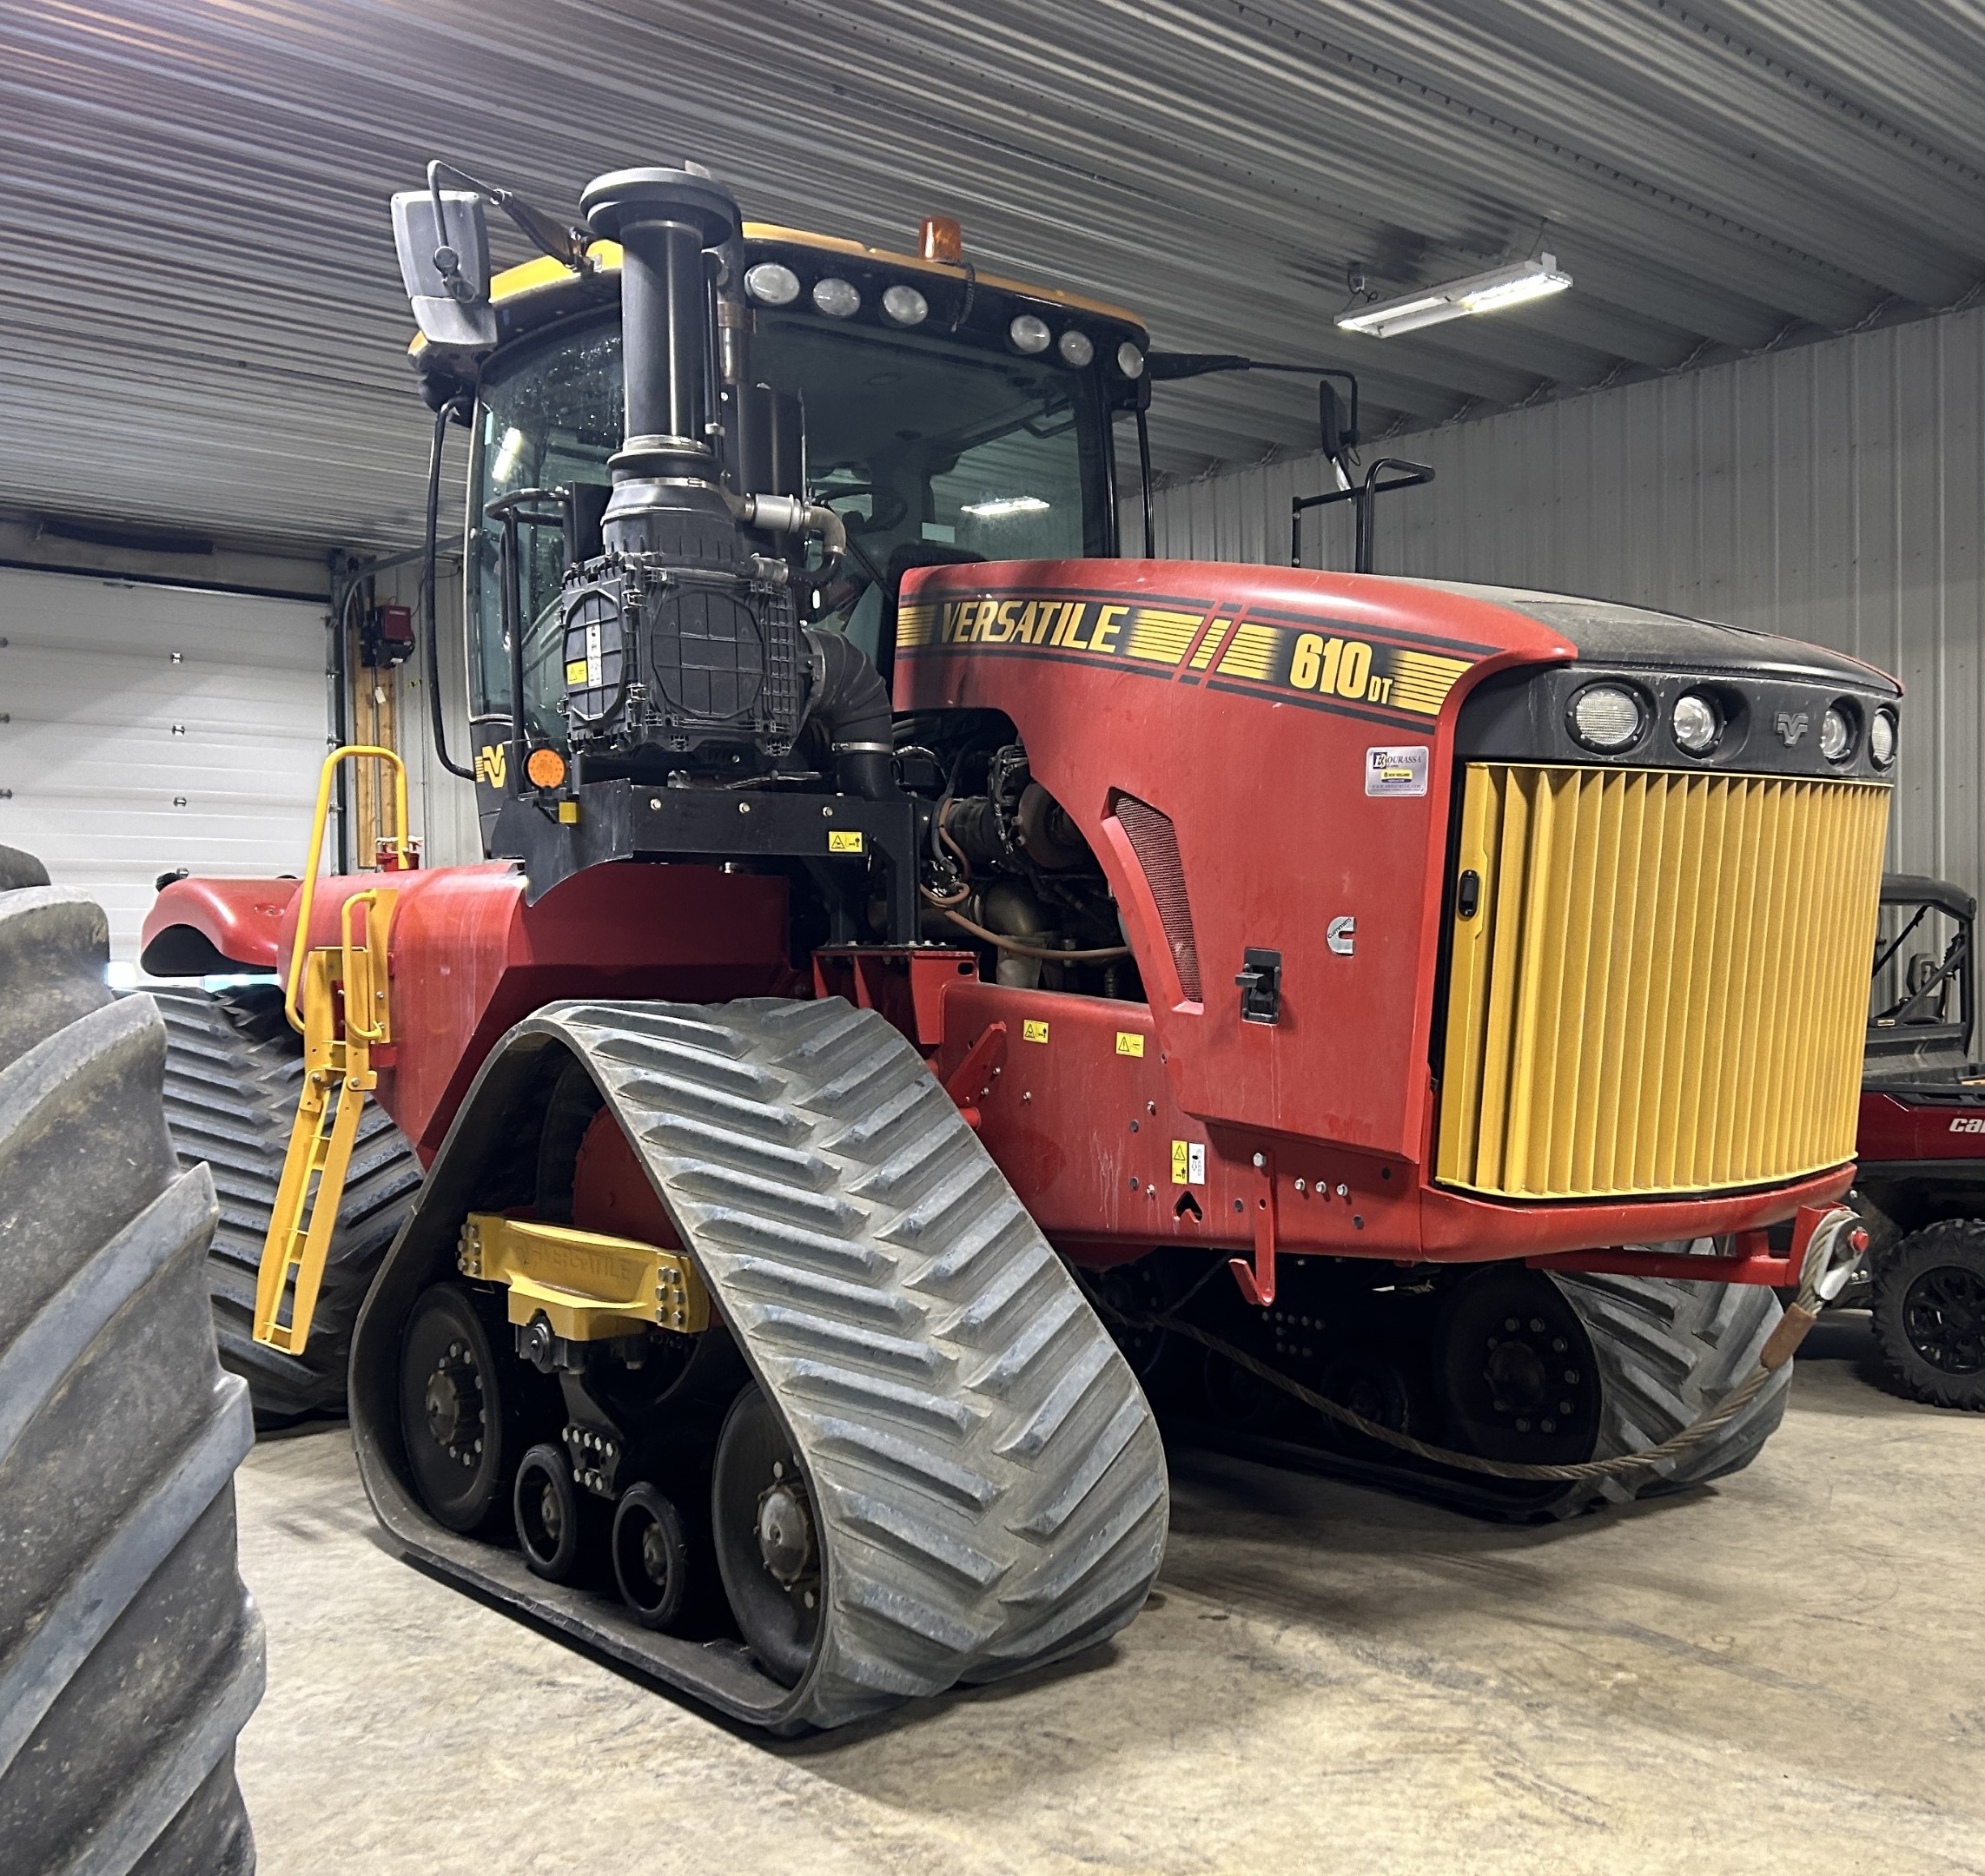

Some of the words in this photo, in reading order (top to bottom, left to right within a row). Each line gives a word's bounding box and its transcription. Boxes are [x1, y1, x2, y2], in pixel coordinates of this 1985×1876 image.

[942, 600, 1129, 653] VERSATILE
[1290, 633, 1373, 698] 610
[1367, 675, 1393, 704] DT
[1373, 752, 1421, 769] BOURASSA
[1328, 918, 1352, 939] Cummins
